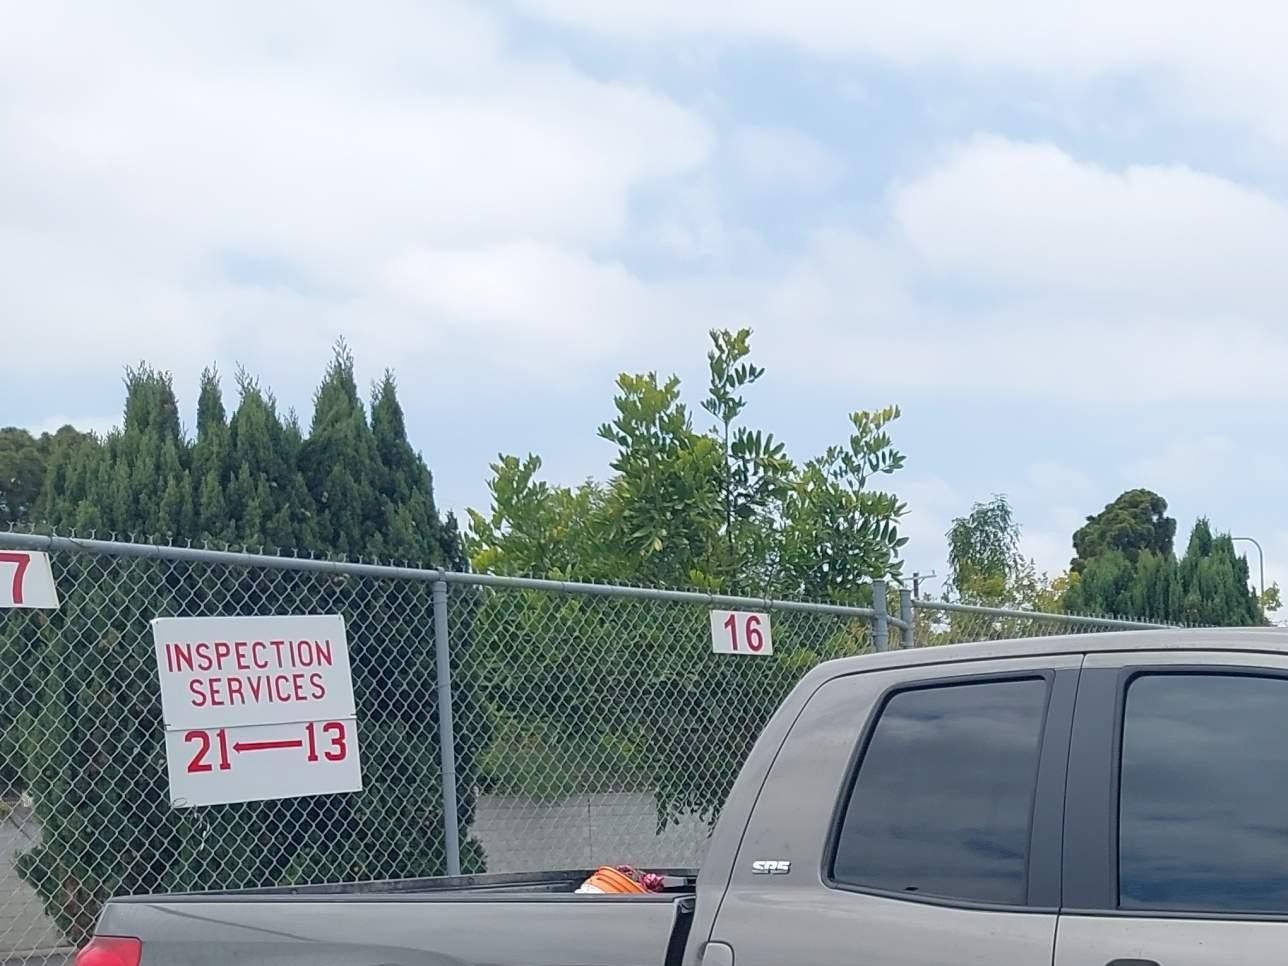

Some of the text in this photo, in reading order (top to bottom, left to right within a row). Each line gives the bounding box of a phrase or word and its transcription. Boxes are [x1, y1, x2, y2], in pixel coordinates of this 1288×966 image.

[0, 553, 31, 604] 7
[724, 614, 764, 652] 16
[165, 640, 333, 673] INSPECTION
[189, 672, 326, 707] SERVICES
[184, 721, 347, 773] 21 13
